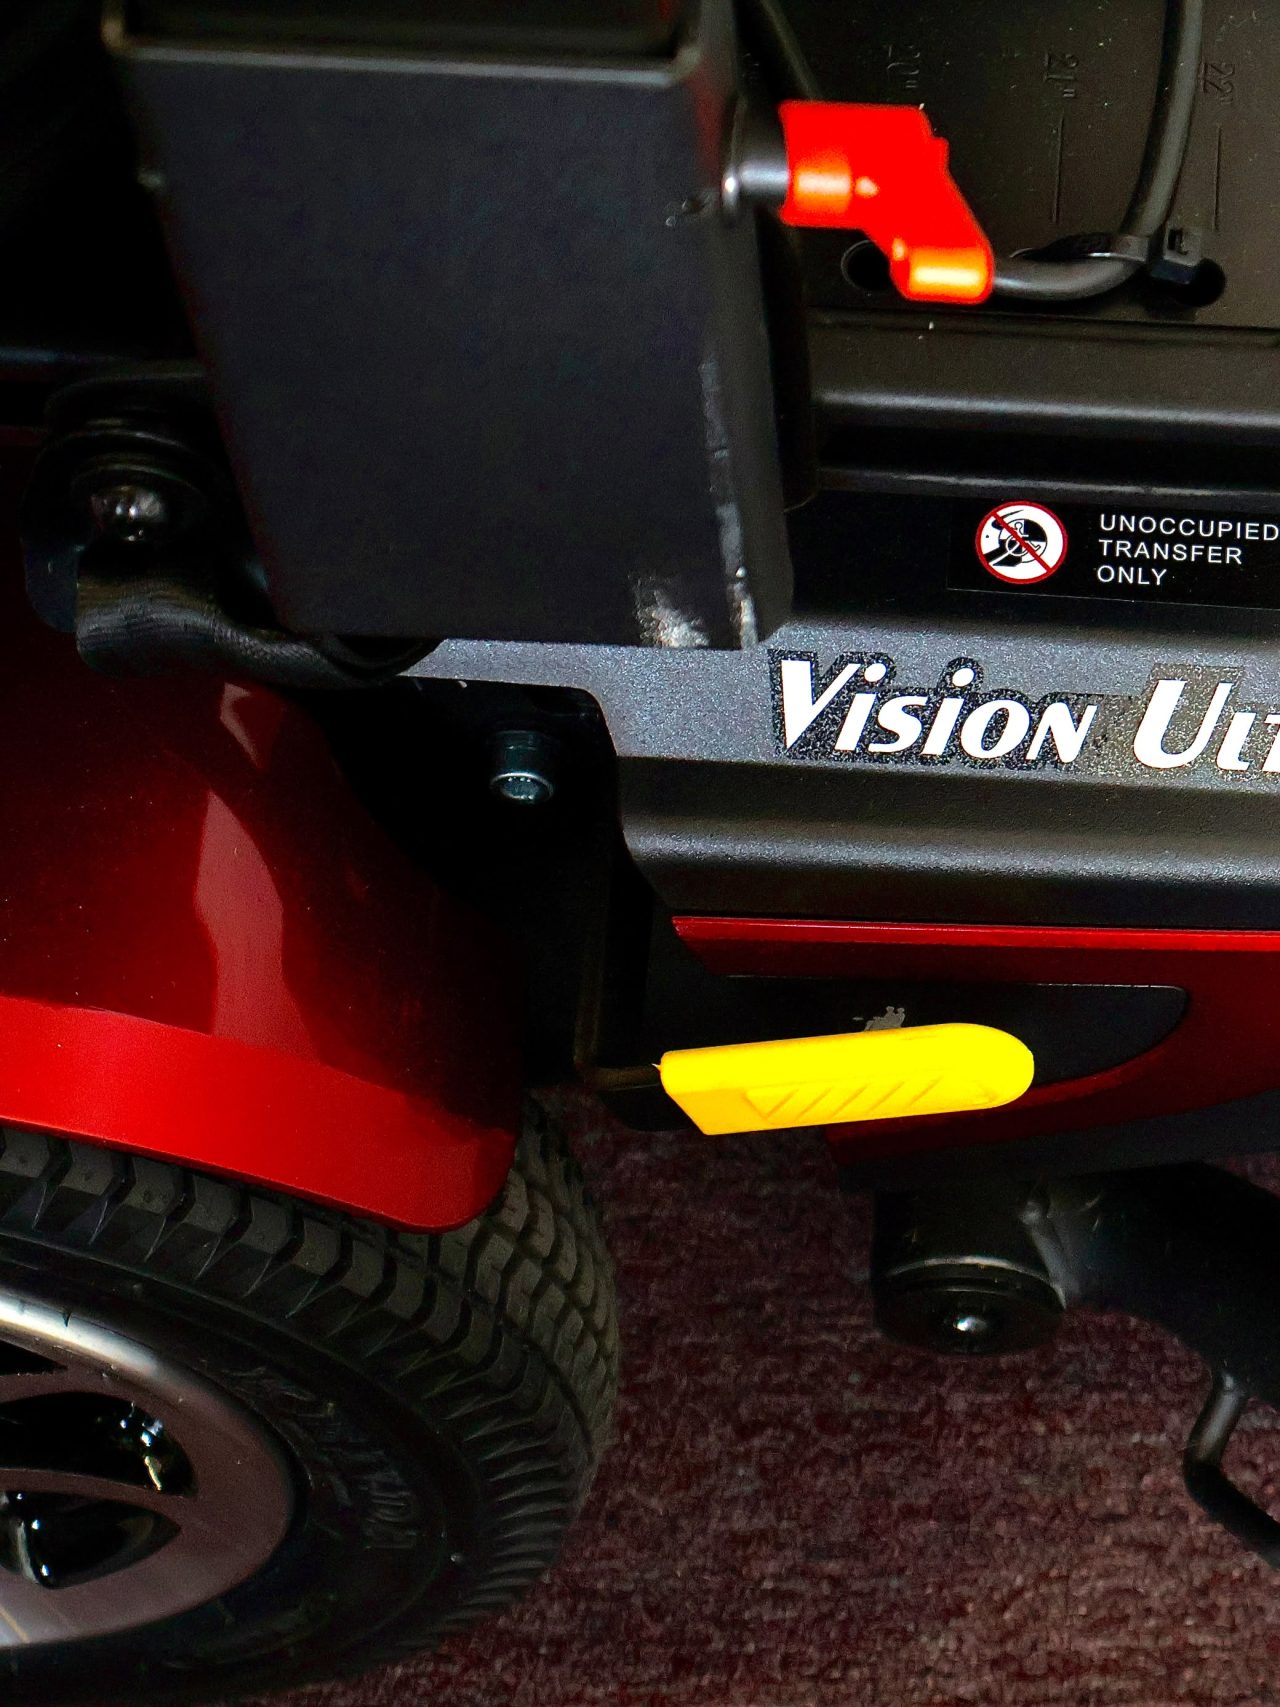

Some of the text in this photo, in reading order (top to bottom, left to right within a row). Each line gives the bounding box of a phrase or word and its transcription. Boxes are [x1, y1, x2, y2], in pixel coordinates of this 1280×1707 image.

[1099, 513, 1280, 541] UNOCCUPIED
[1098, 539, 1242, 565] TRANSFER
[1097, 564, 1167, 586] ONLY
